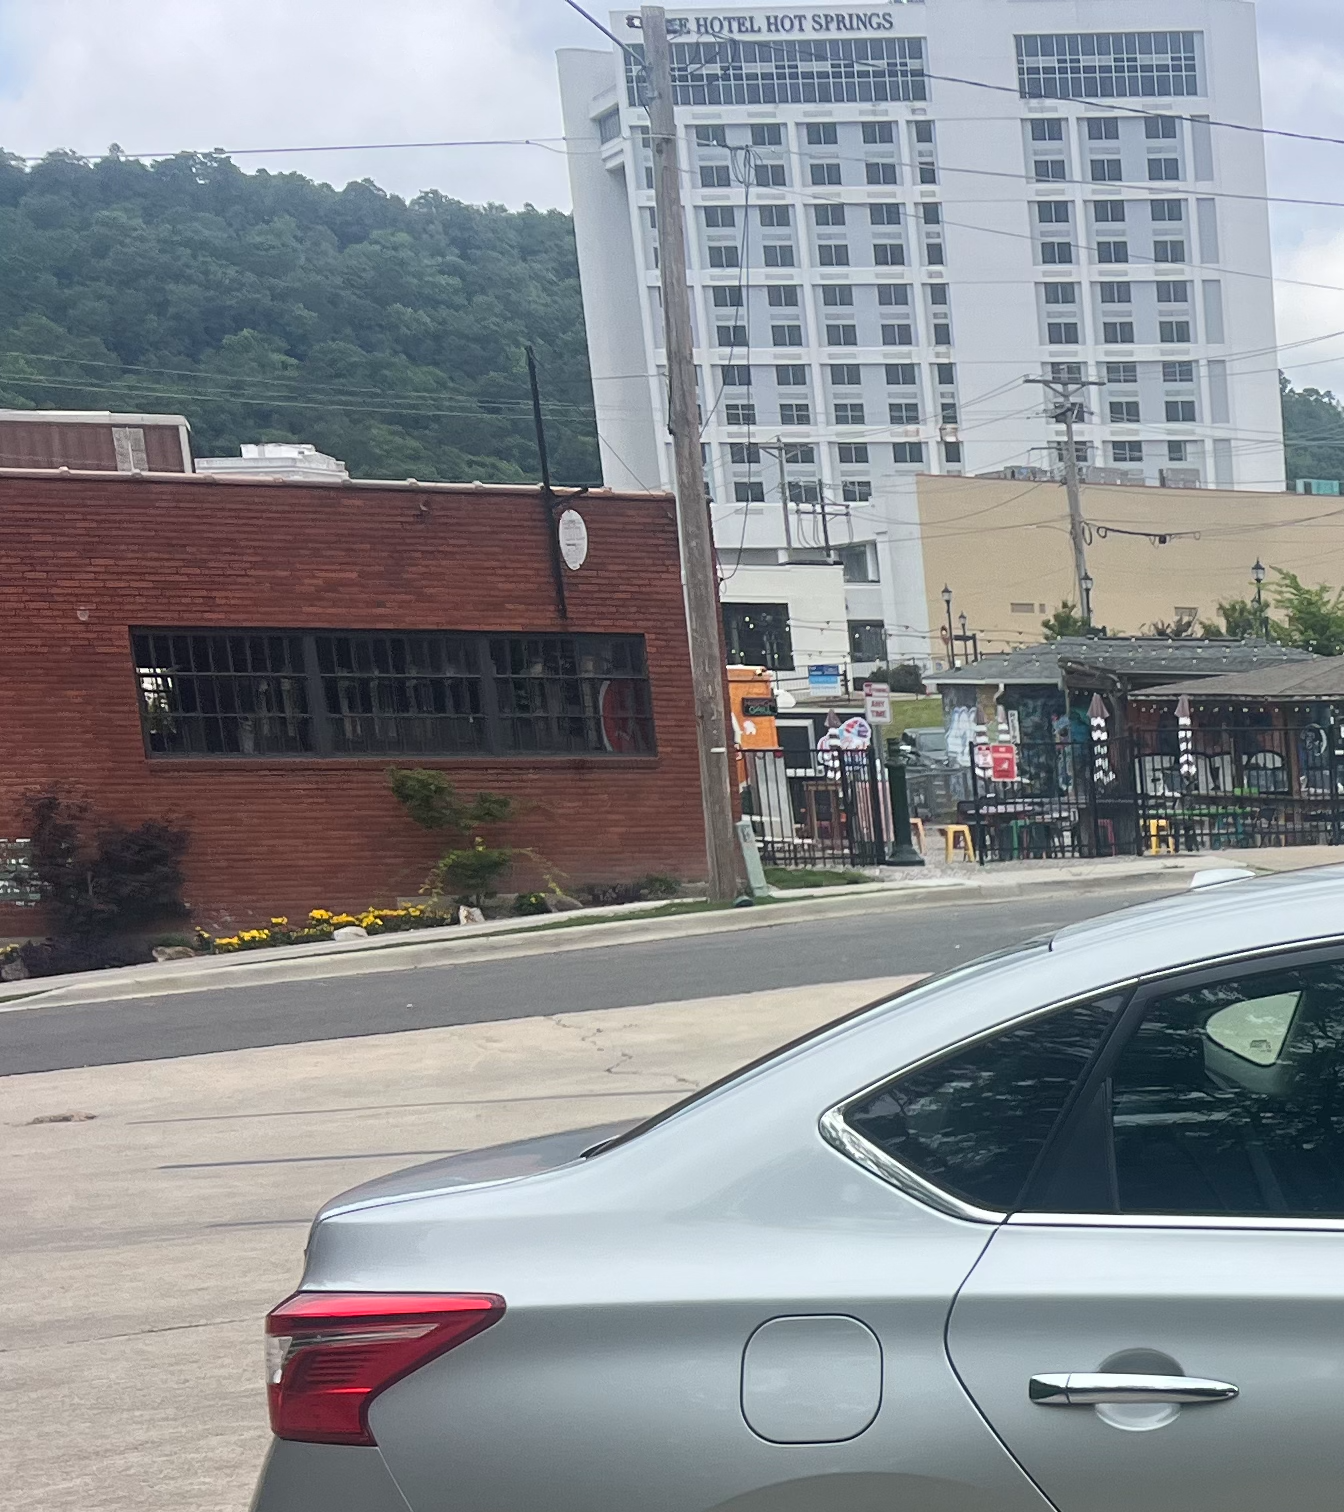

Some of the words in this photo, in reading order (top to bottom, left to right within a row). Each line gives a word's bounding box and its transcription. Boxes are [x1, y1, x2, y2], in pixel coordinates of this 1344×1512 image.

[695, 16, 761, 34] HOTEL
[766, 15, 807, 33] HOT
[811, 12, 894, 32] SPRINGS
